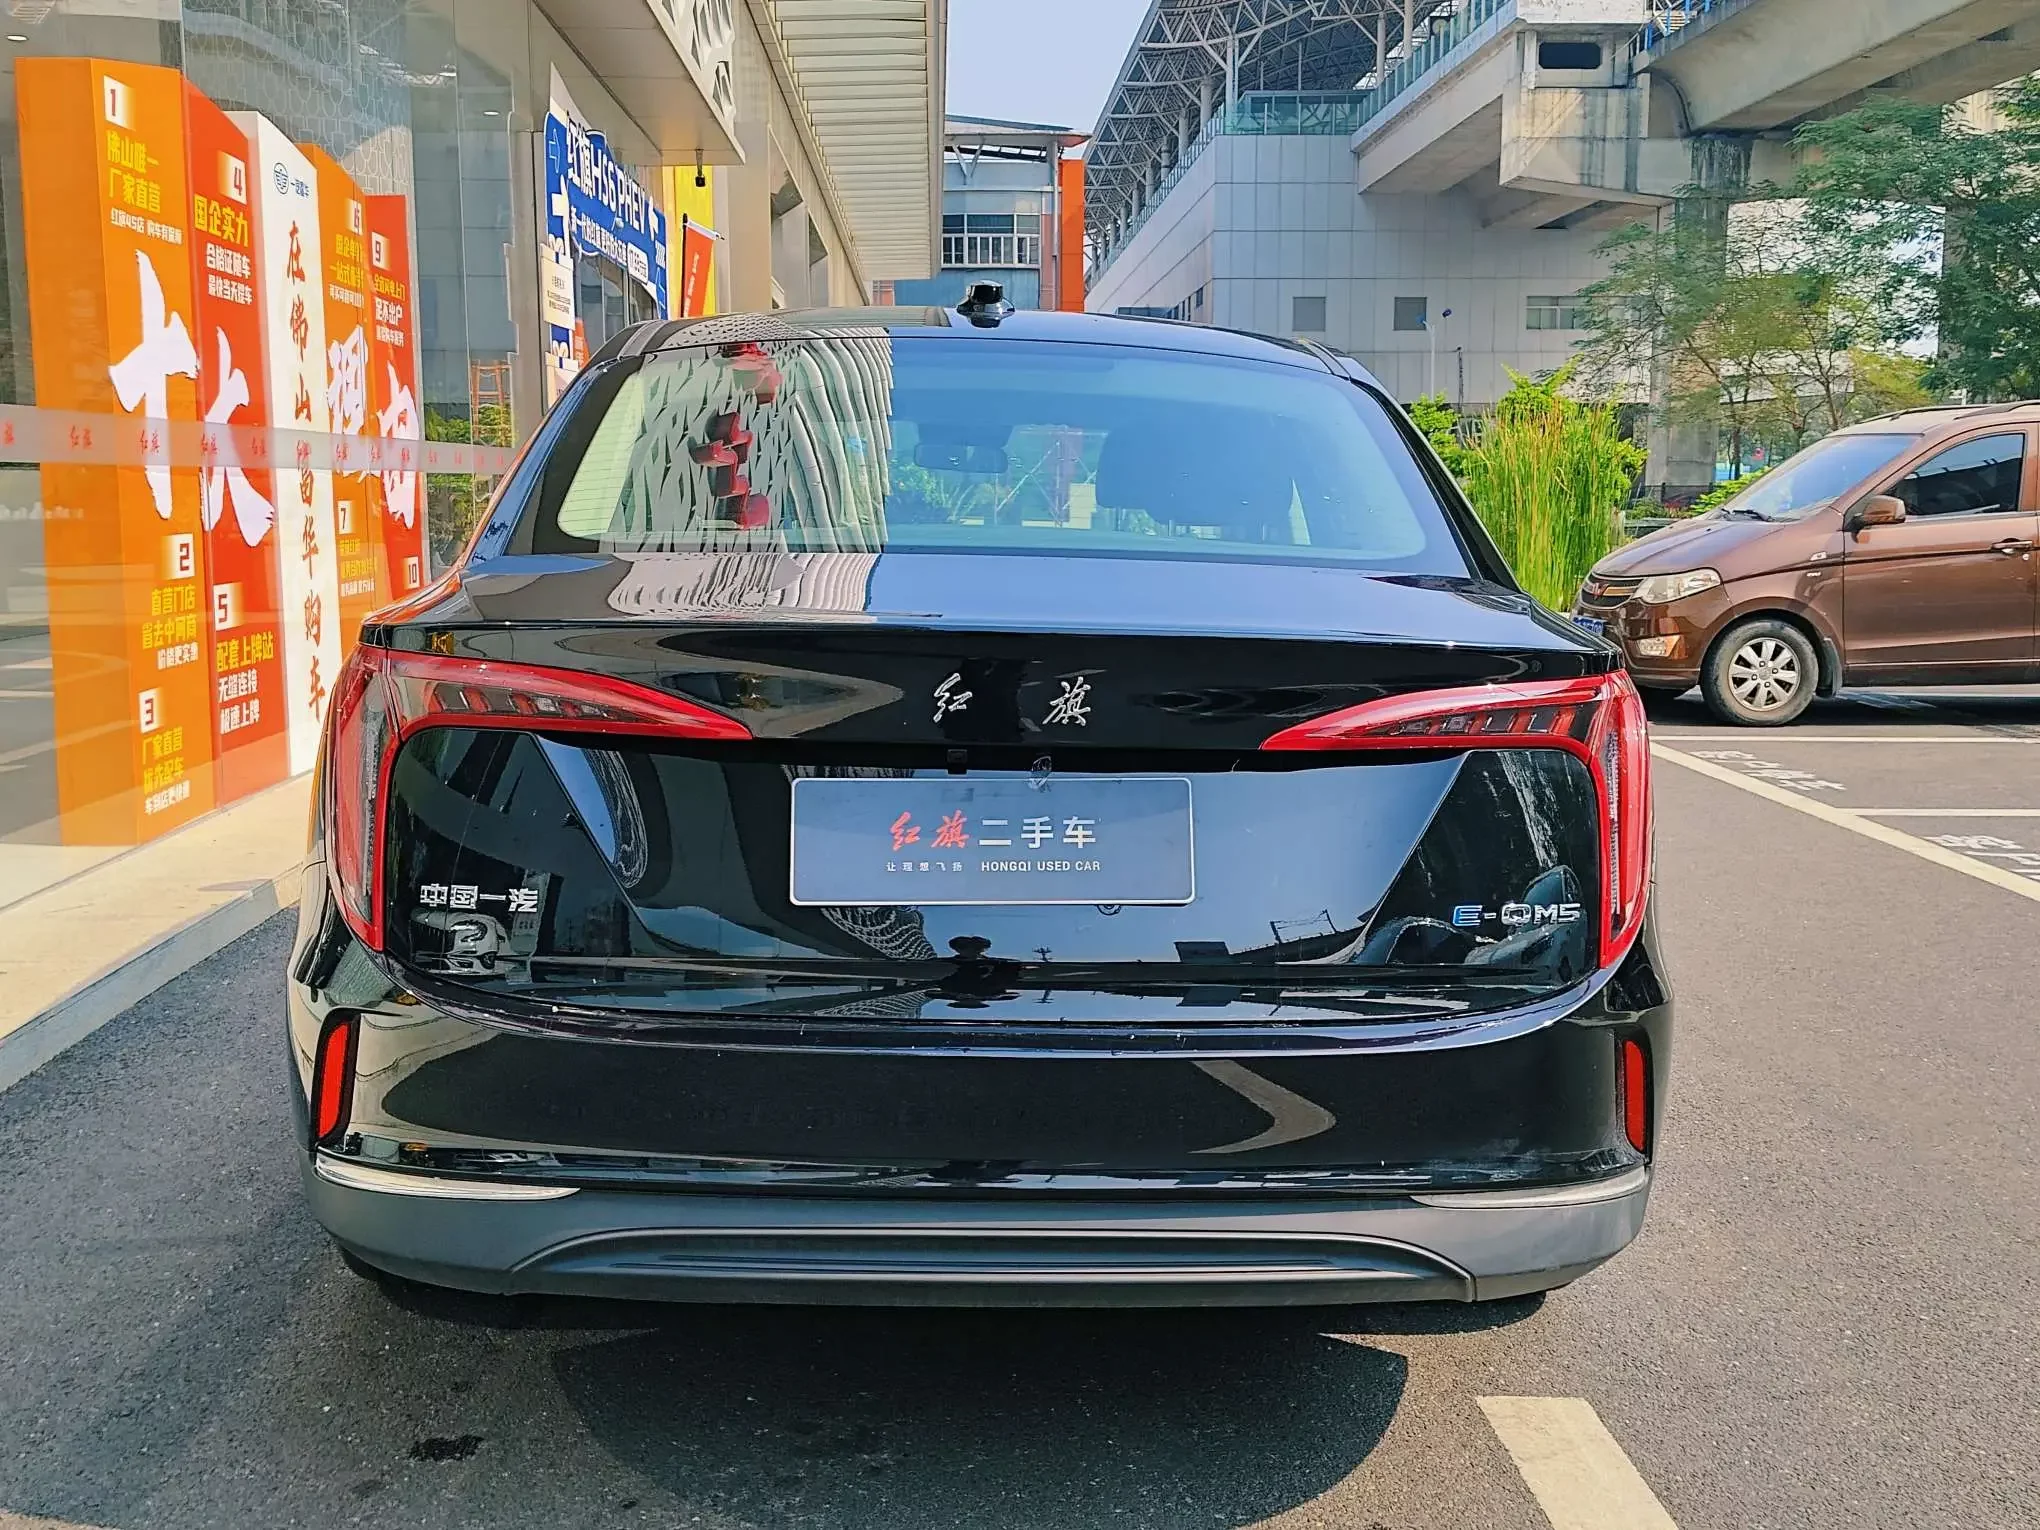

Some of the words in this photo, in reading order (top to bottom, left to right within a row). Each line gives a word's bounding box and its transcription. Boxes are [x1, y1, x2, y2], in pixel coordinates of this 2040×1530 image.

[110, 89, 116, 116] 1
[109, 168, 160, 213] 厂家直营
[233, 167, 242, 196] 4
[616, 166, 646, 234] PHEV
[194, 193, 248, 247] 国企实力
[207, 242, 251, 279] 合格证随车
[375, 241, 381, 262] 9
[208, 274, 252, 305] 最快当天提车
[340, 507, 347, 530] 7
[179, 543, 190, 571] 2
[408, 563, 417, 585] 10
[151, 584, 196, 616] 直营门店
[218, 593, 228, 623] 5
[216, 631, 274, 673] 配套上牌站
[144, 697, 154, 726] 3
[932, 673, 1093, 727] 红旗
[889, 809, 1097, 852] 红旗二手车
[886, 861, 963, 873] 让理想飞扬
[980, 860, 1032, 872] HONGQI
[1037, 860, 1071, 872] USED
[1075, 860, 1102, 872] CAR
[420, 883, 539, 913] 中国一汽
[1452, 902, 1581, 928] E-QM5
